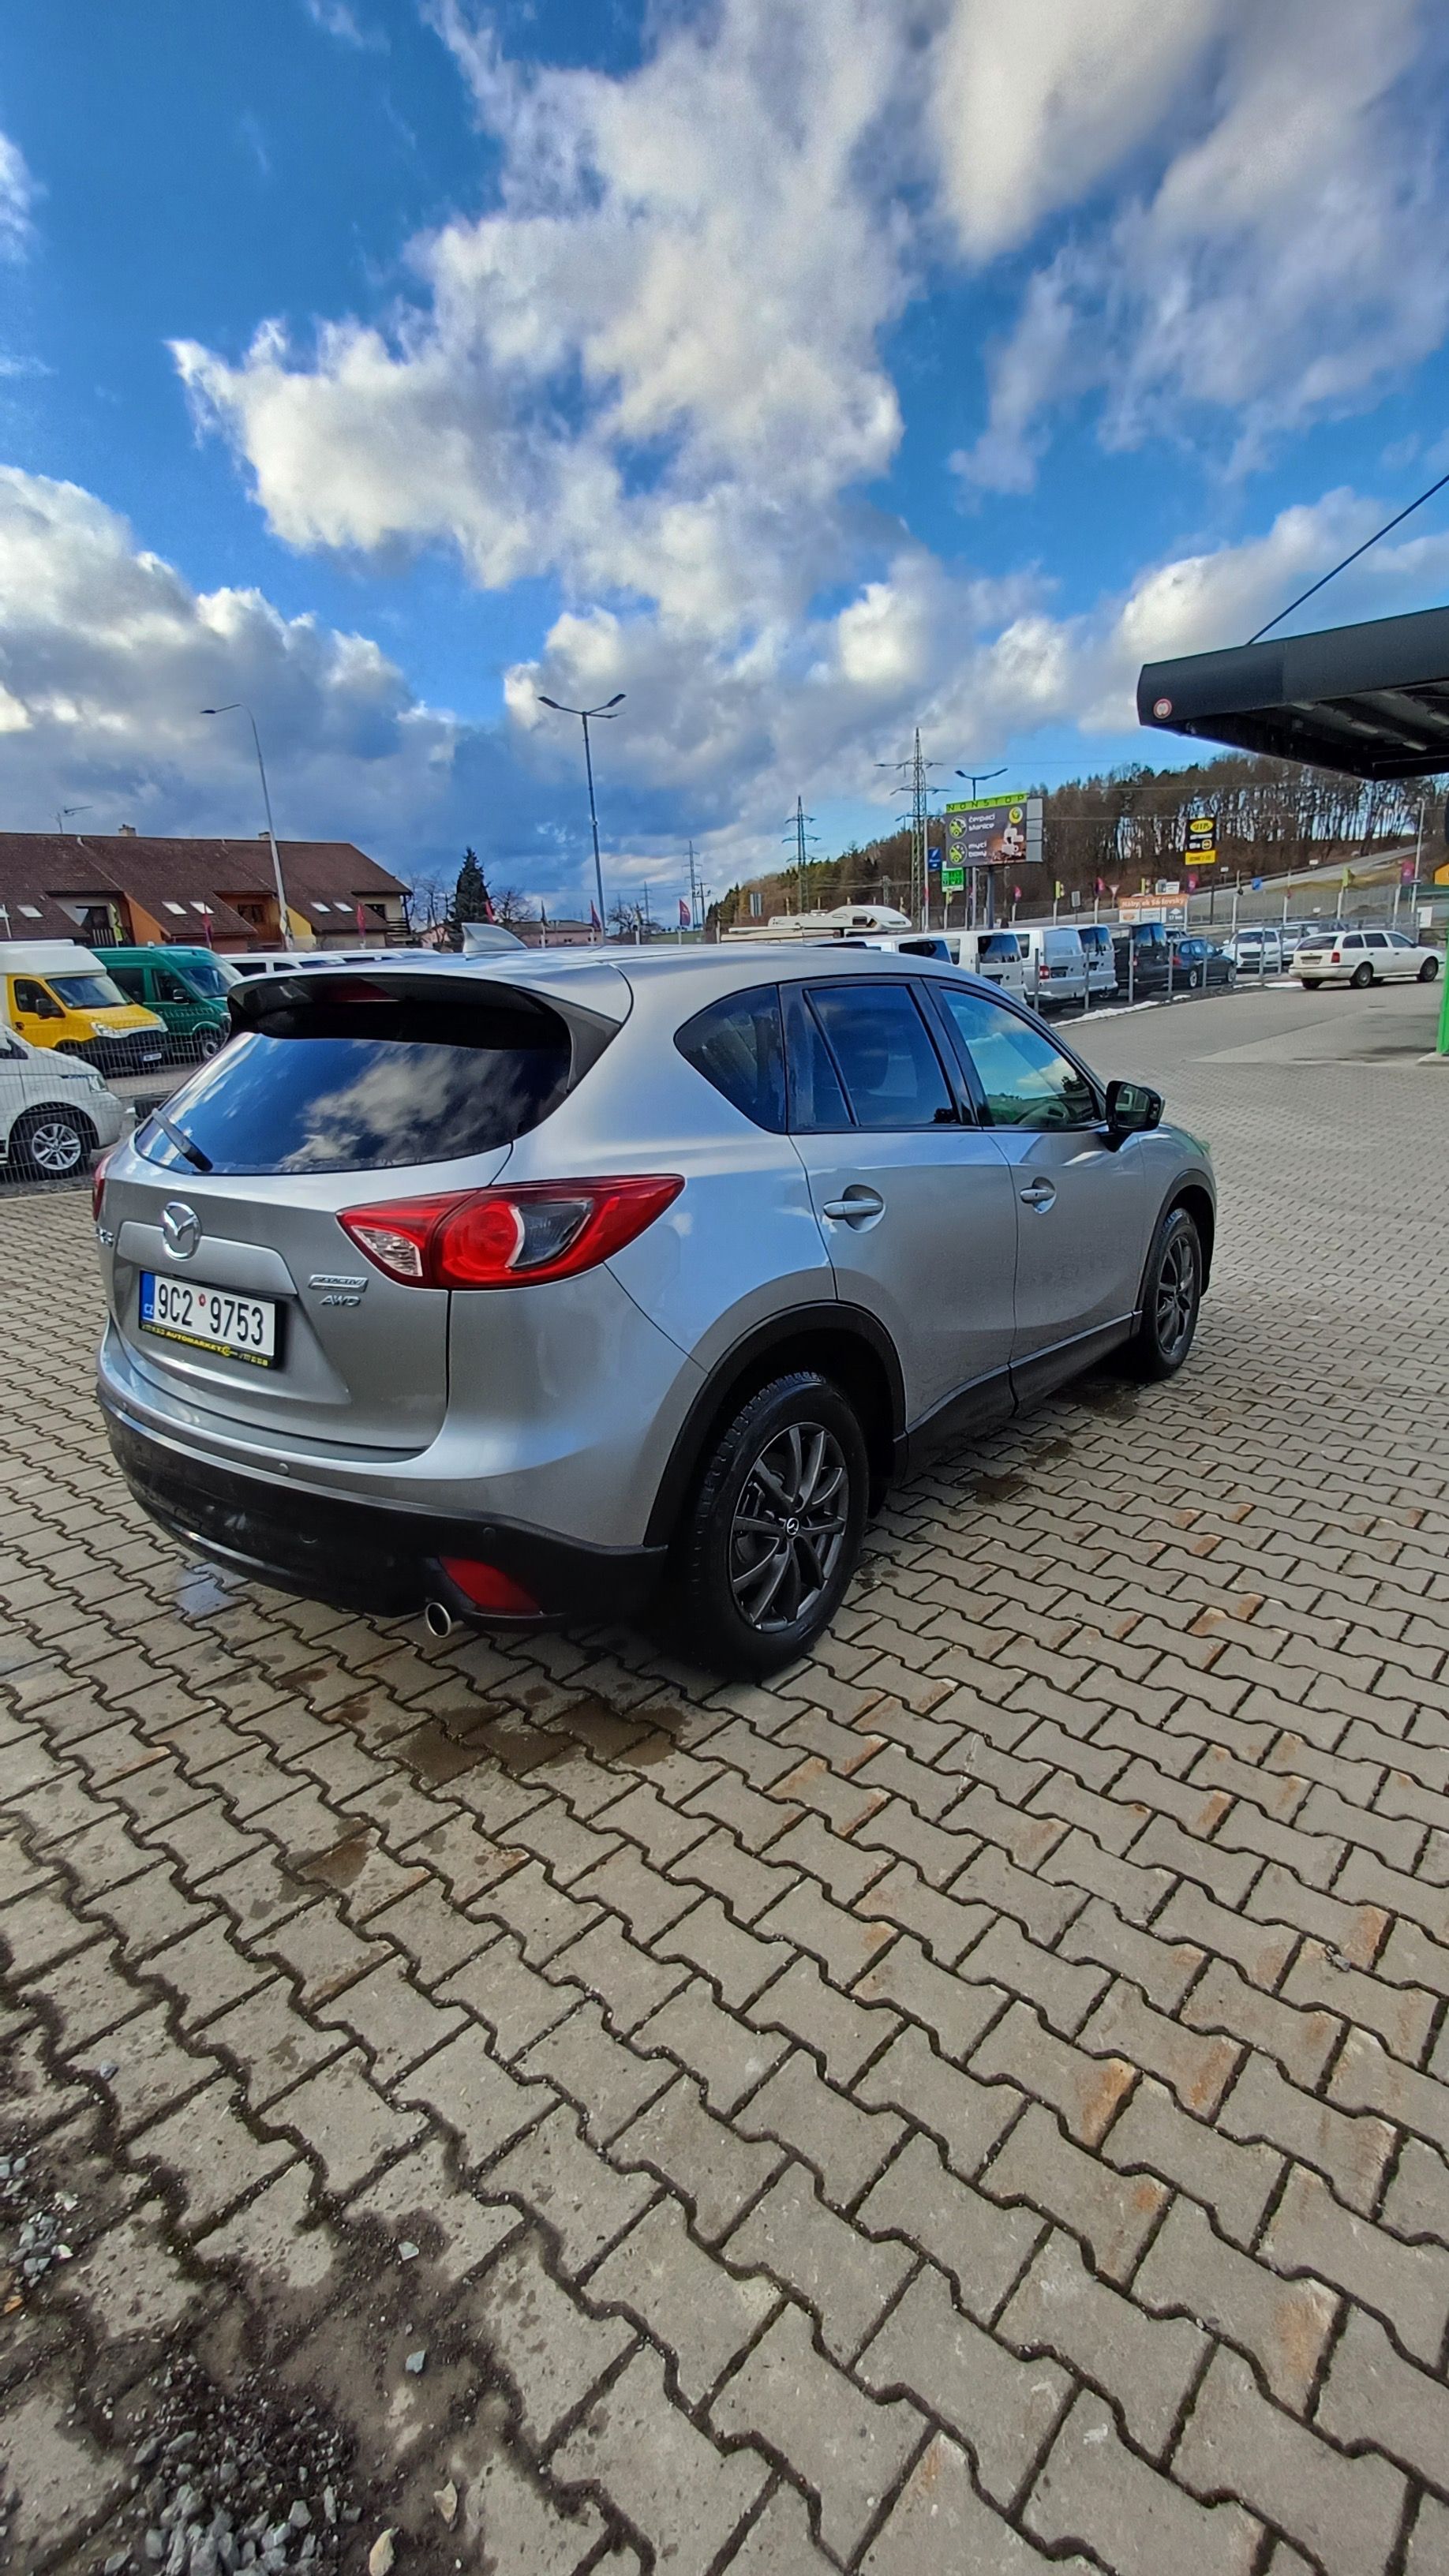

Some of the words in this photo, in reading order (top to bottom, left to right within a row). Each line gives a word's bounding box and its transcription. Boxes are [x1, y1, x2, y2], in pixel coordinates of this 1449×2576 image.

[948, 795, 1024, 811] NONSTOP
[319, 1294, 361, 1307] AWD
[144, 1303, 153, 1315] CZ
[158, 1283, 193, 1327] 9C2
[210, 1296, 264, 1346] 9753
